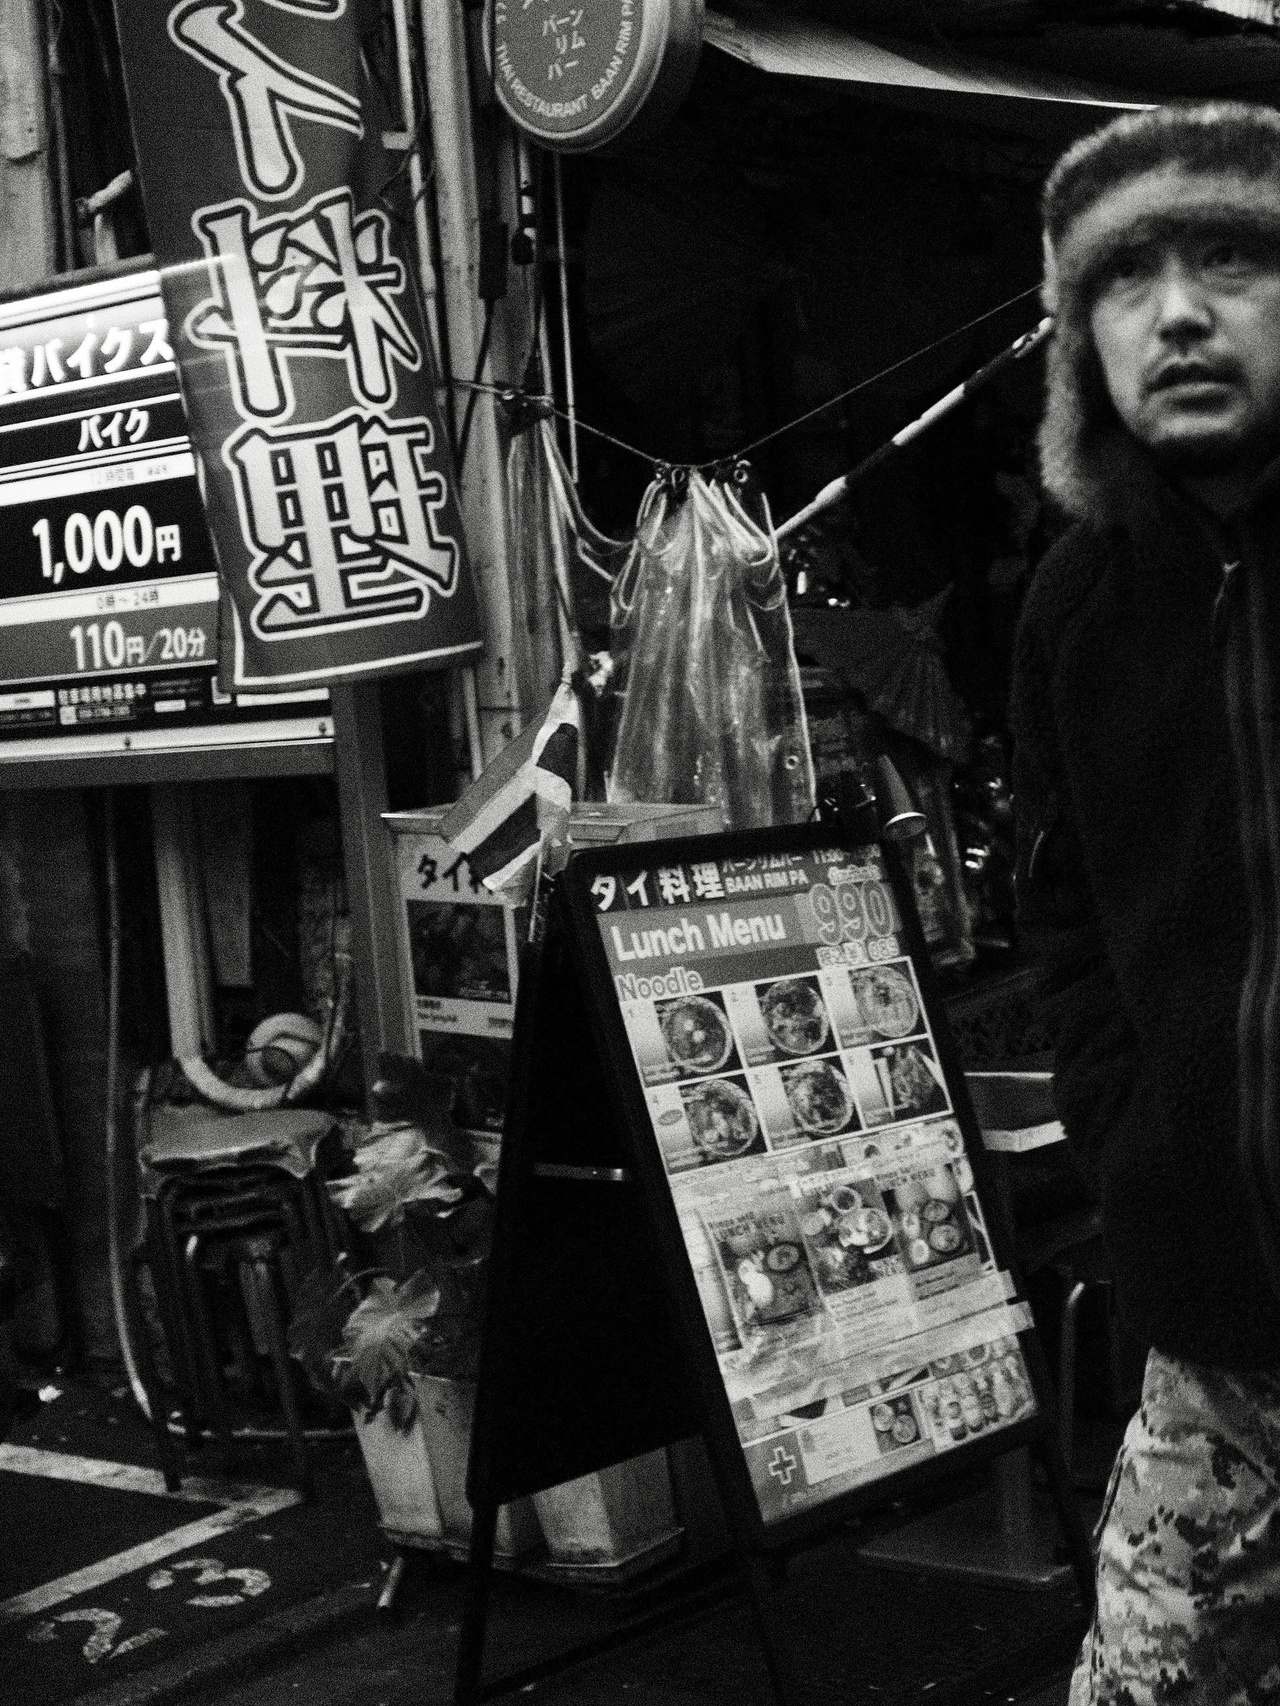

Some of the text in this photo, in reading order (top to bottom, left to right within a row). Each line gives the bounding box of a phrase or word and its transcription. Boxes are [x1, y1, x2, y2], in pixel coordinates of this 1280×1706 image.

[510, 78, 588, 119] RESTAURANT
[77, 407, 149, 451] バイク
[32, 504, 182, 585] 1,000円
[70, 620, 206, 670] 110円/20分
[591, 862, 725, 911] タイ料理
[725, 872, 763, 893] BAAN
[763, 871, 789, 889] RIM
[788, 868, 809, 886] PA
[611, 911, 787, 961] Lunch Menu
[809, 879, 894, 947] 990
[614, 965, 704, 1001] Noodle
